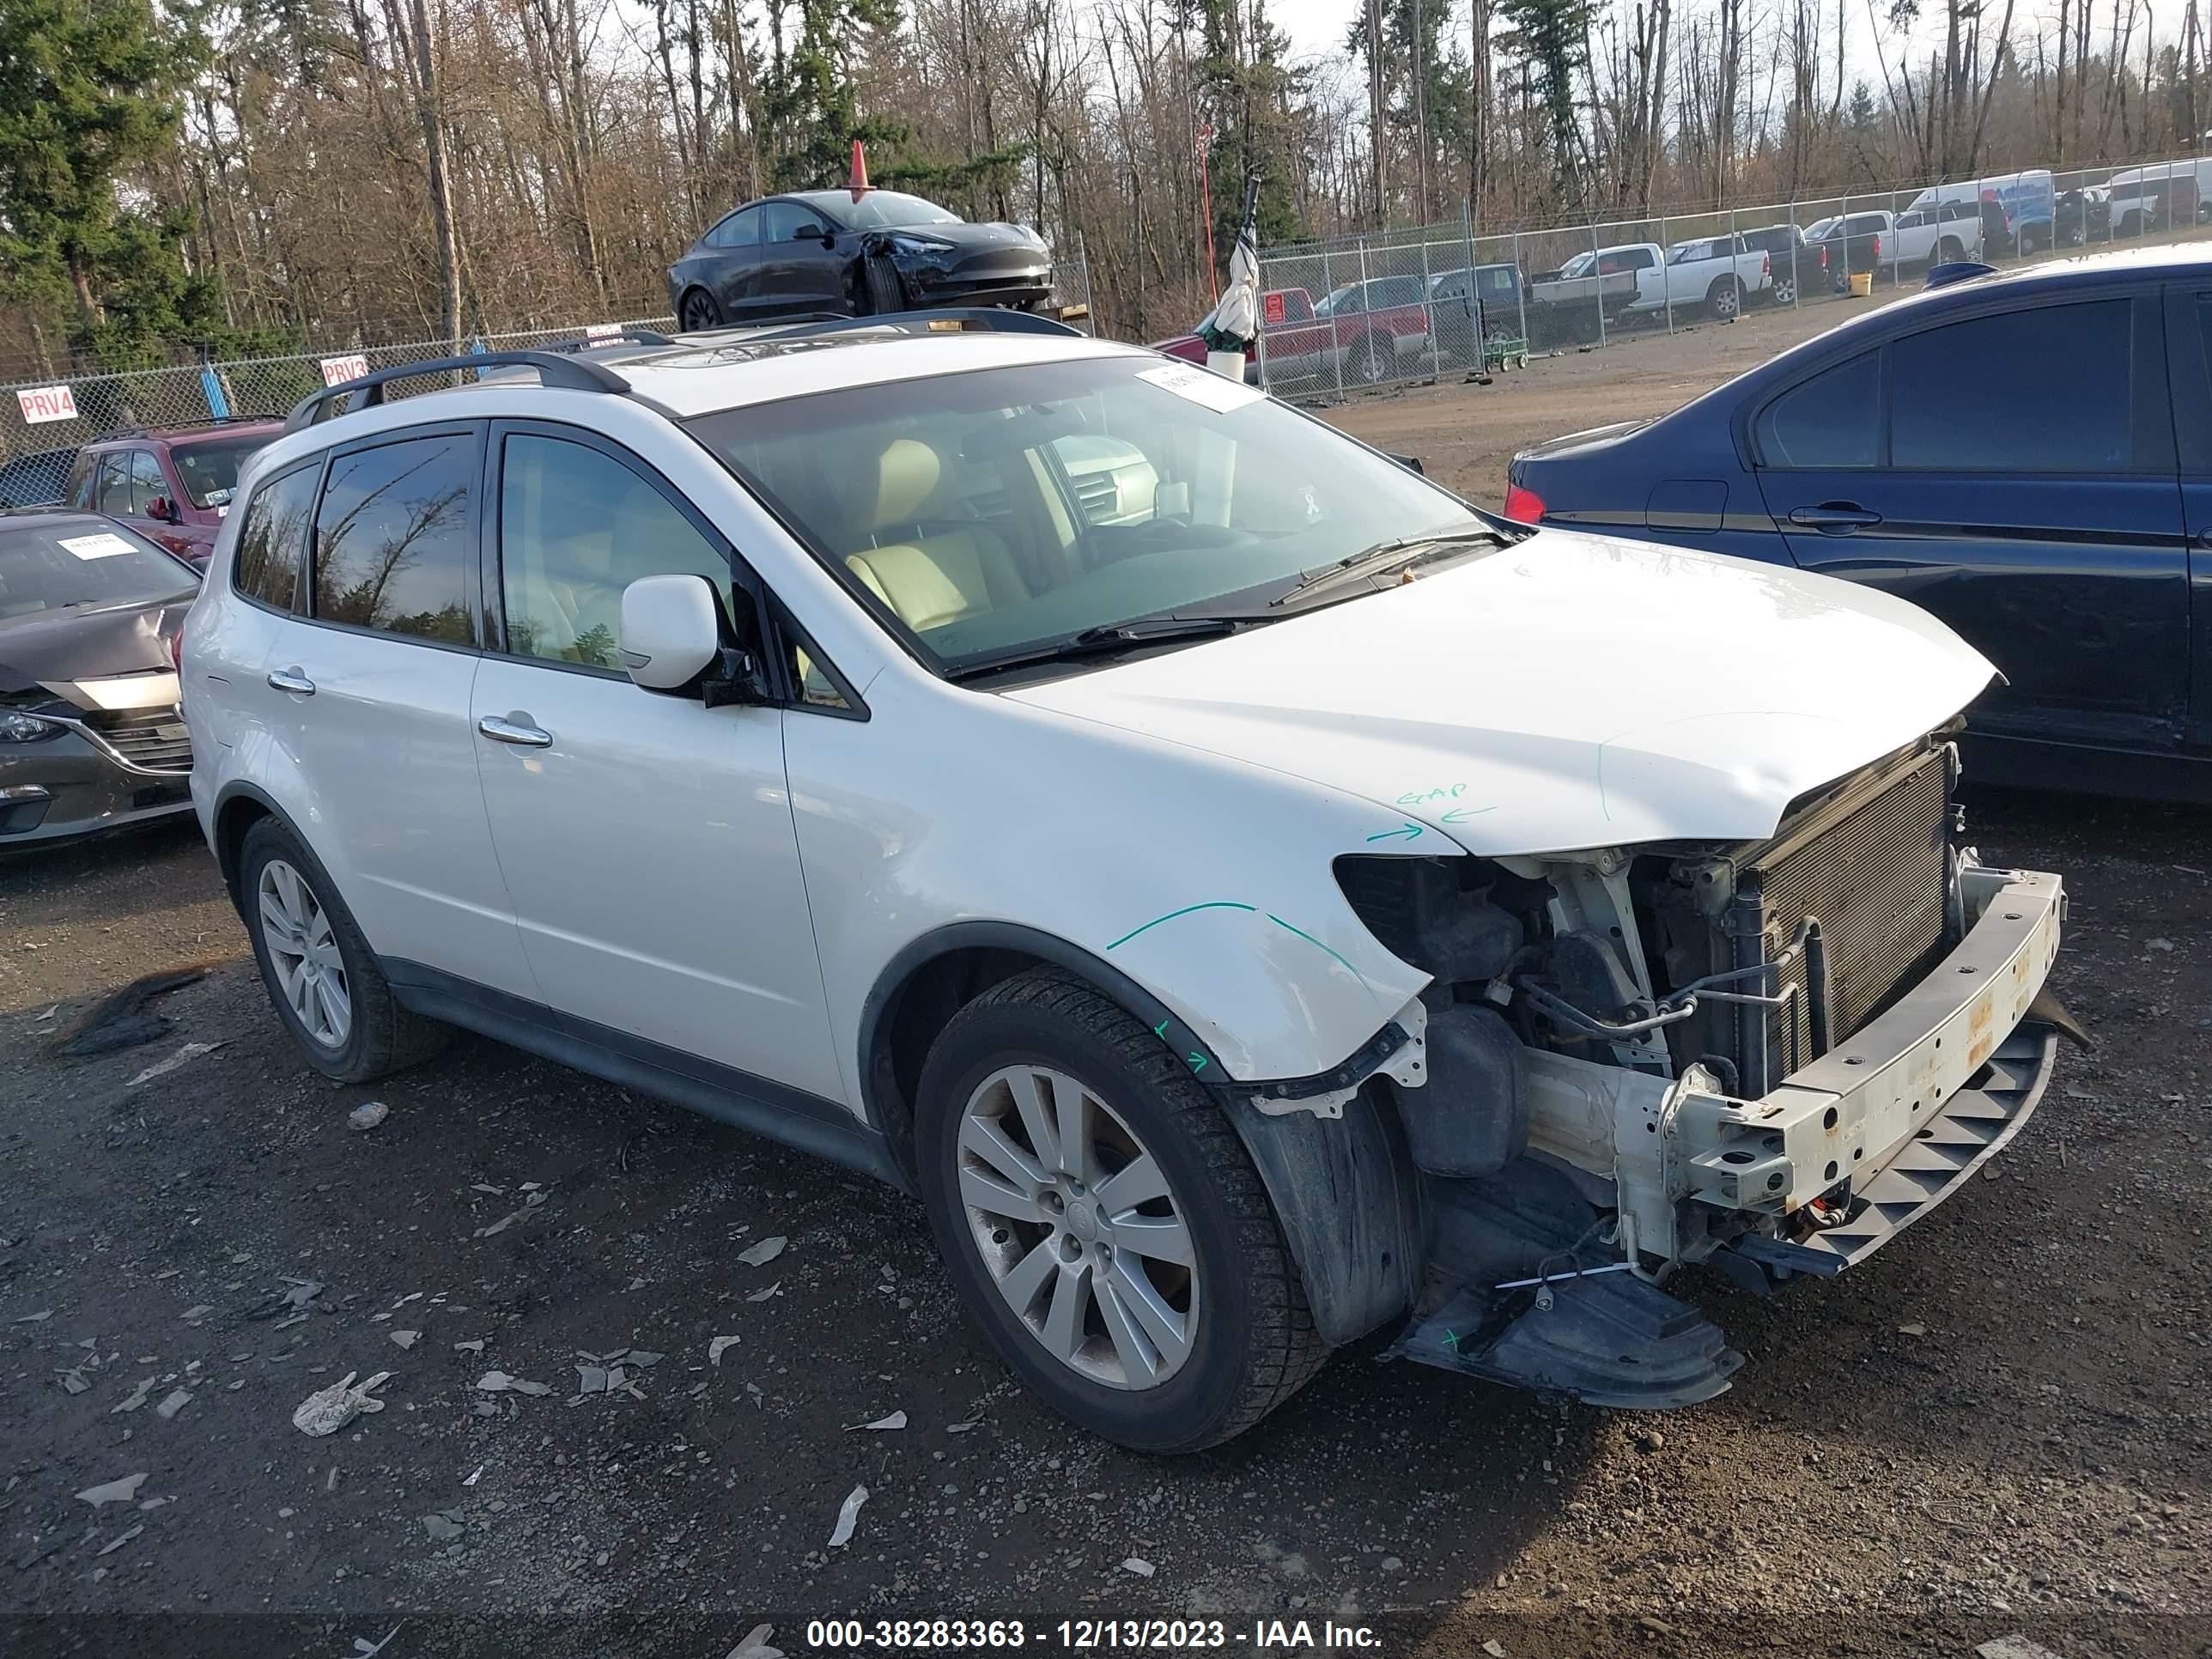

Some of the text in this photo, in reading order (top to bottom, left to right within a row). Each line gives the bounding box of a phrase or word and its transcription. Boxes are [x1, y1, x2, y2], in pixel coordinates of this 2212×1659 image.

[324, 361, 367, 385] PRV3
[20, 392, 74, 417] PRV4
[1396, 783, 1467, 805] GAP
